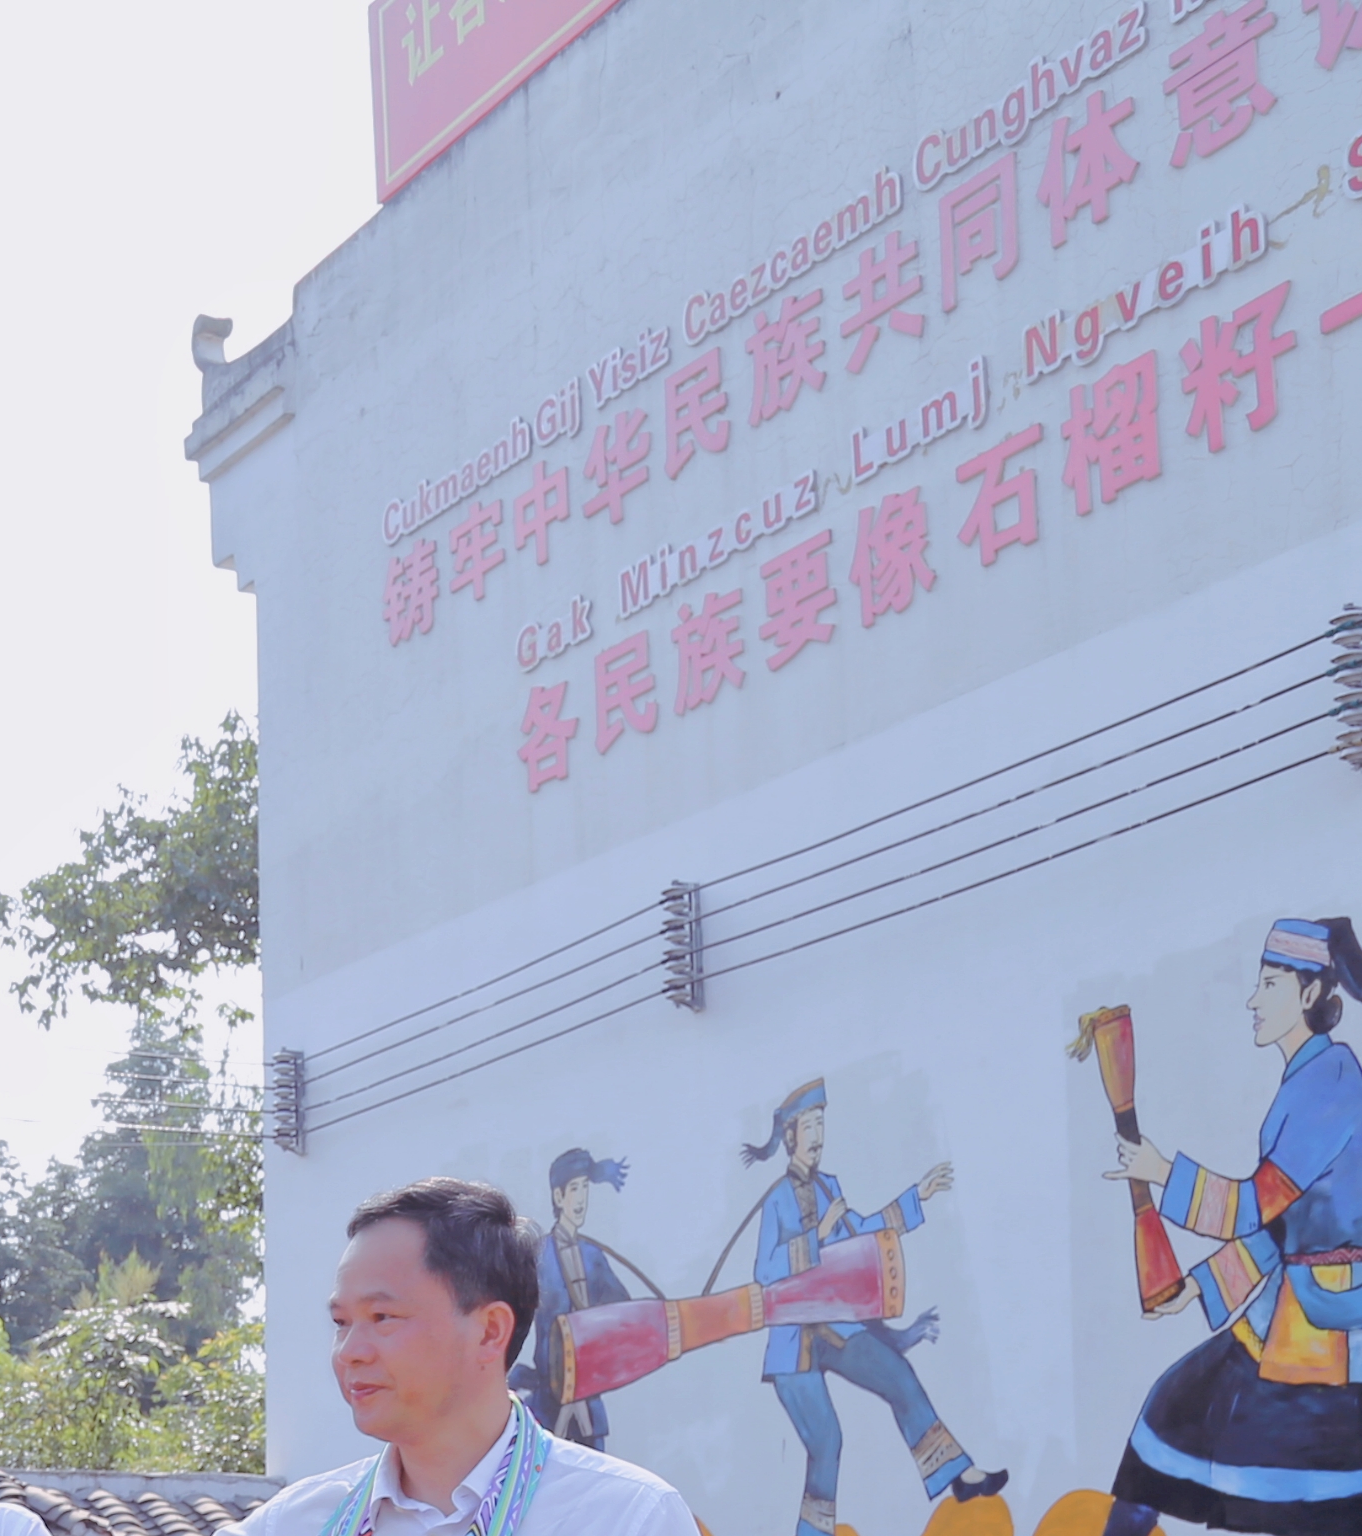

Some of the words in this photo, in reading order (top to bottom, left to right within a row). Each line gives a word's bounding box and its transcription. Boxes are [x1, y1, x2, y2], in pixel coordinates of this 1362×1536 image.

[384, 421, 529, 540] Cukmaenh
[536, 382, 578, 440] Gij
[589, 331, 668, 402] Yisiz
[685, 171, 897, 341] Caezcaemh
[916, 8, 1142, 184] Cunghvaz
[518, 597, 588, 667] Gak
[620, 474, 812, 615] Minzcuz
[853, 361, 982, 478] Lumj
[1025, 210, 1260, 377] Ngveih
